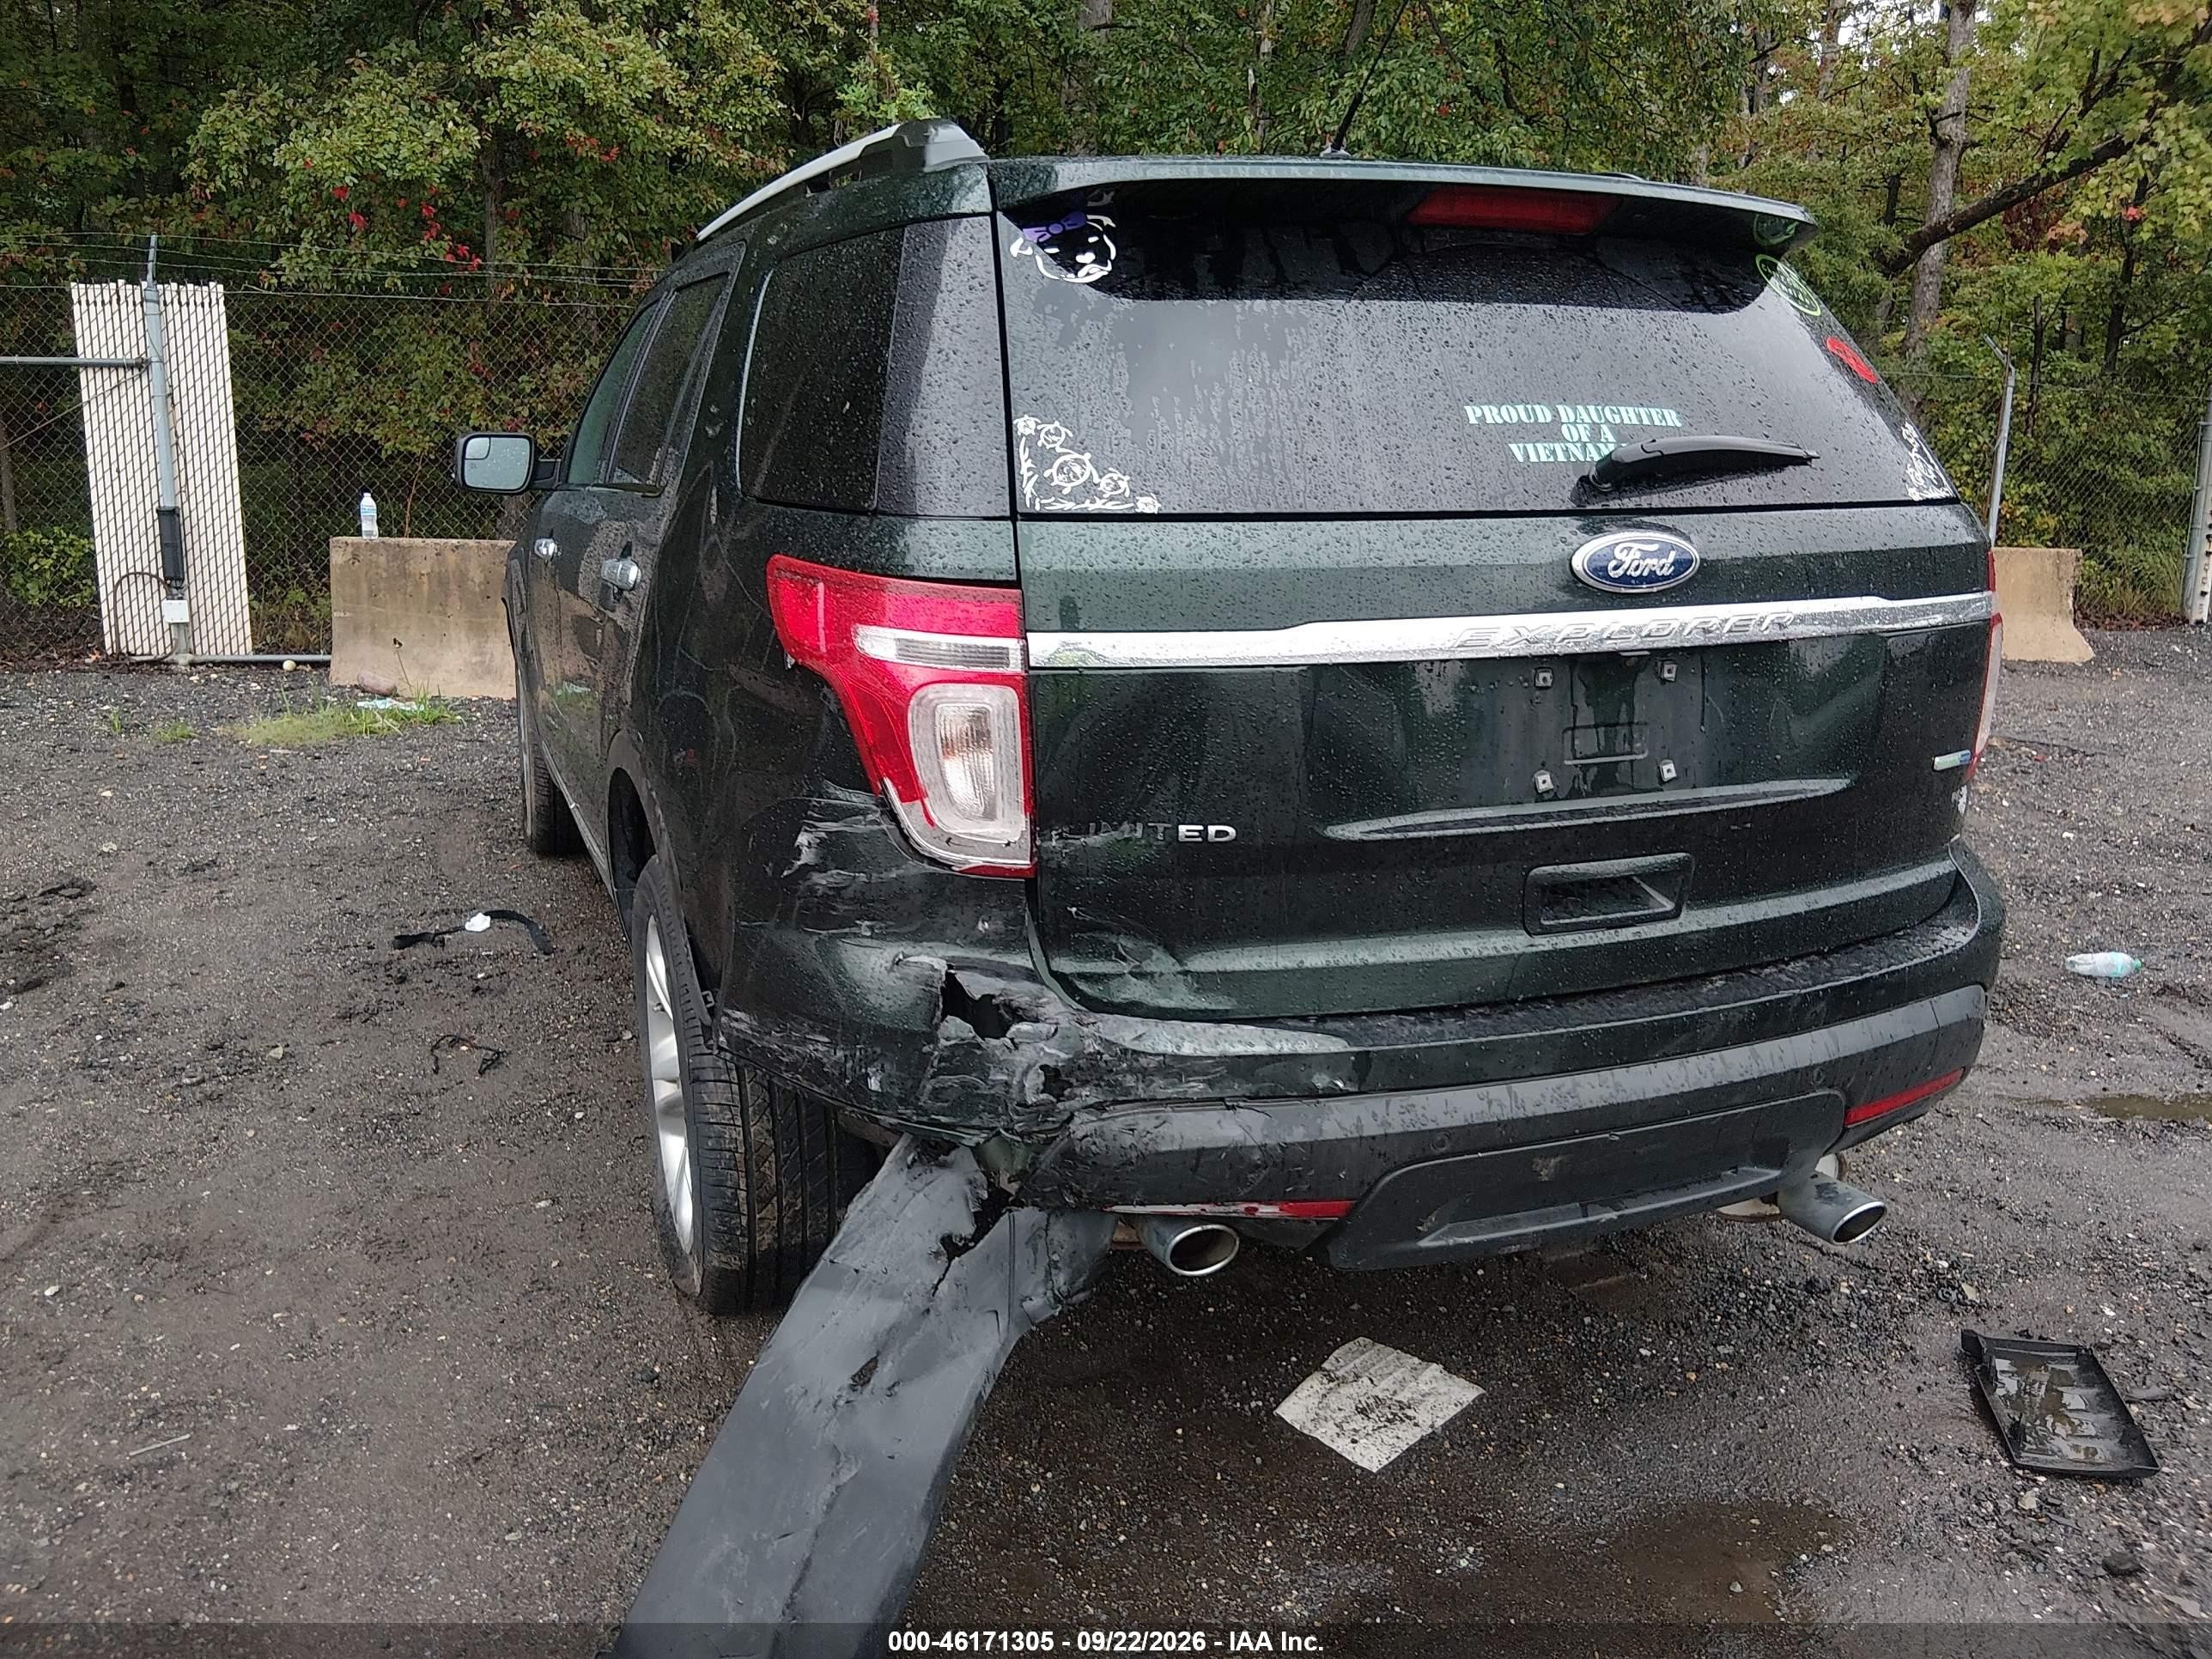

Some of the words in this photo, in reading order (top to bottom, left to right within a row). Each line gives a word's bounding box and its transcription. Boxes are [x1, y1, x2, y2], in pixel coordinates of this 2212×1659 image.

[1463, 404, 1553, 425] PROUD
[1555, 404, 1683, 428] DAUGHTER
[1560, 423, 1591, 443] OF
[1600, 423, 1616, 442] A
[1607, 542, 1676, 579] Ford
[1455, 611, 1796, 650] EXPLORER
